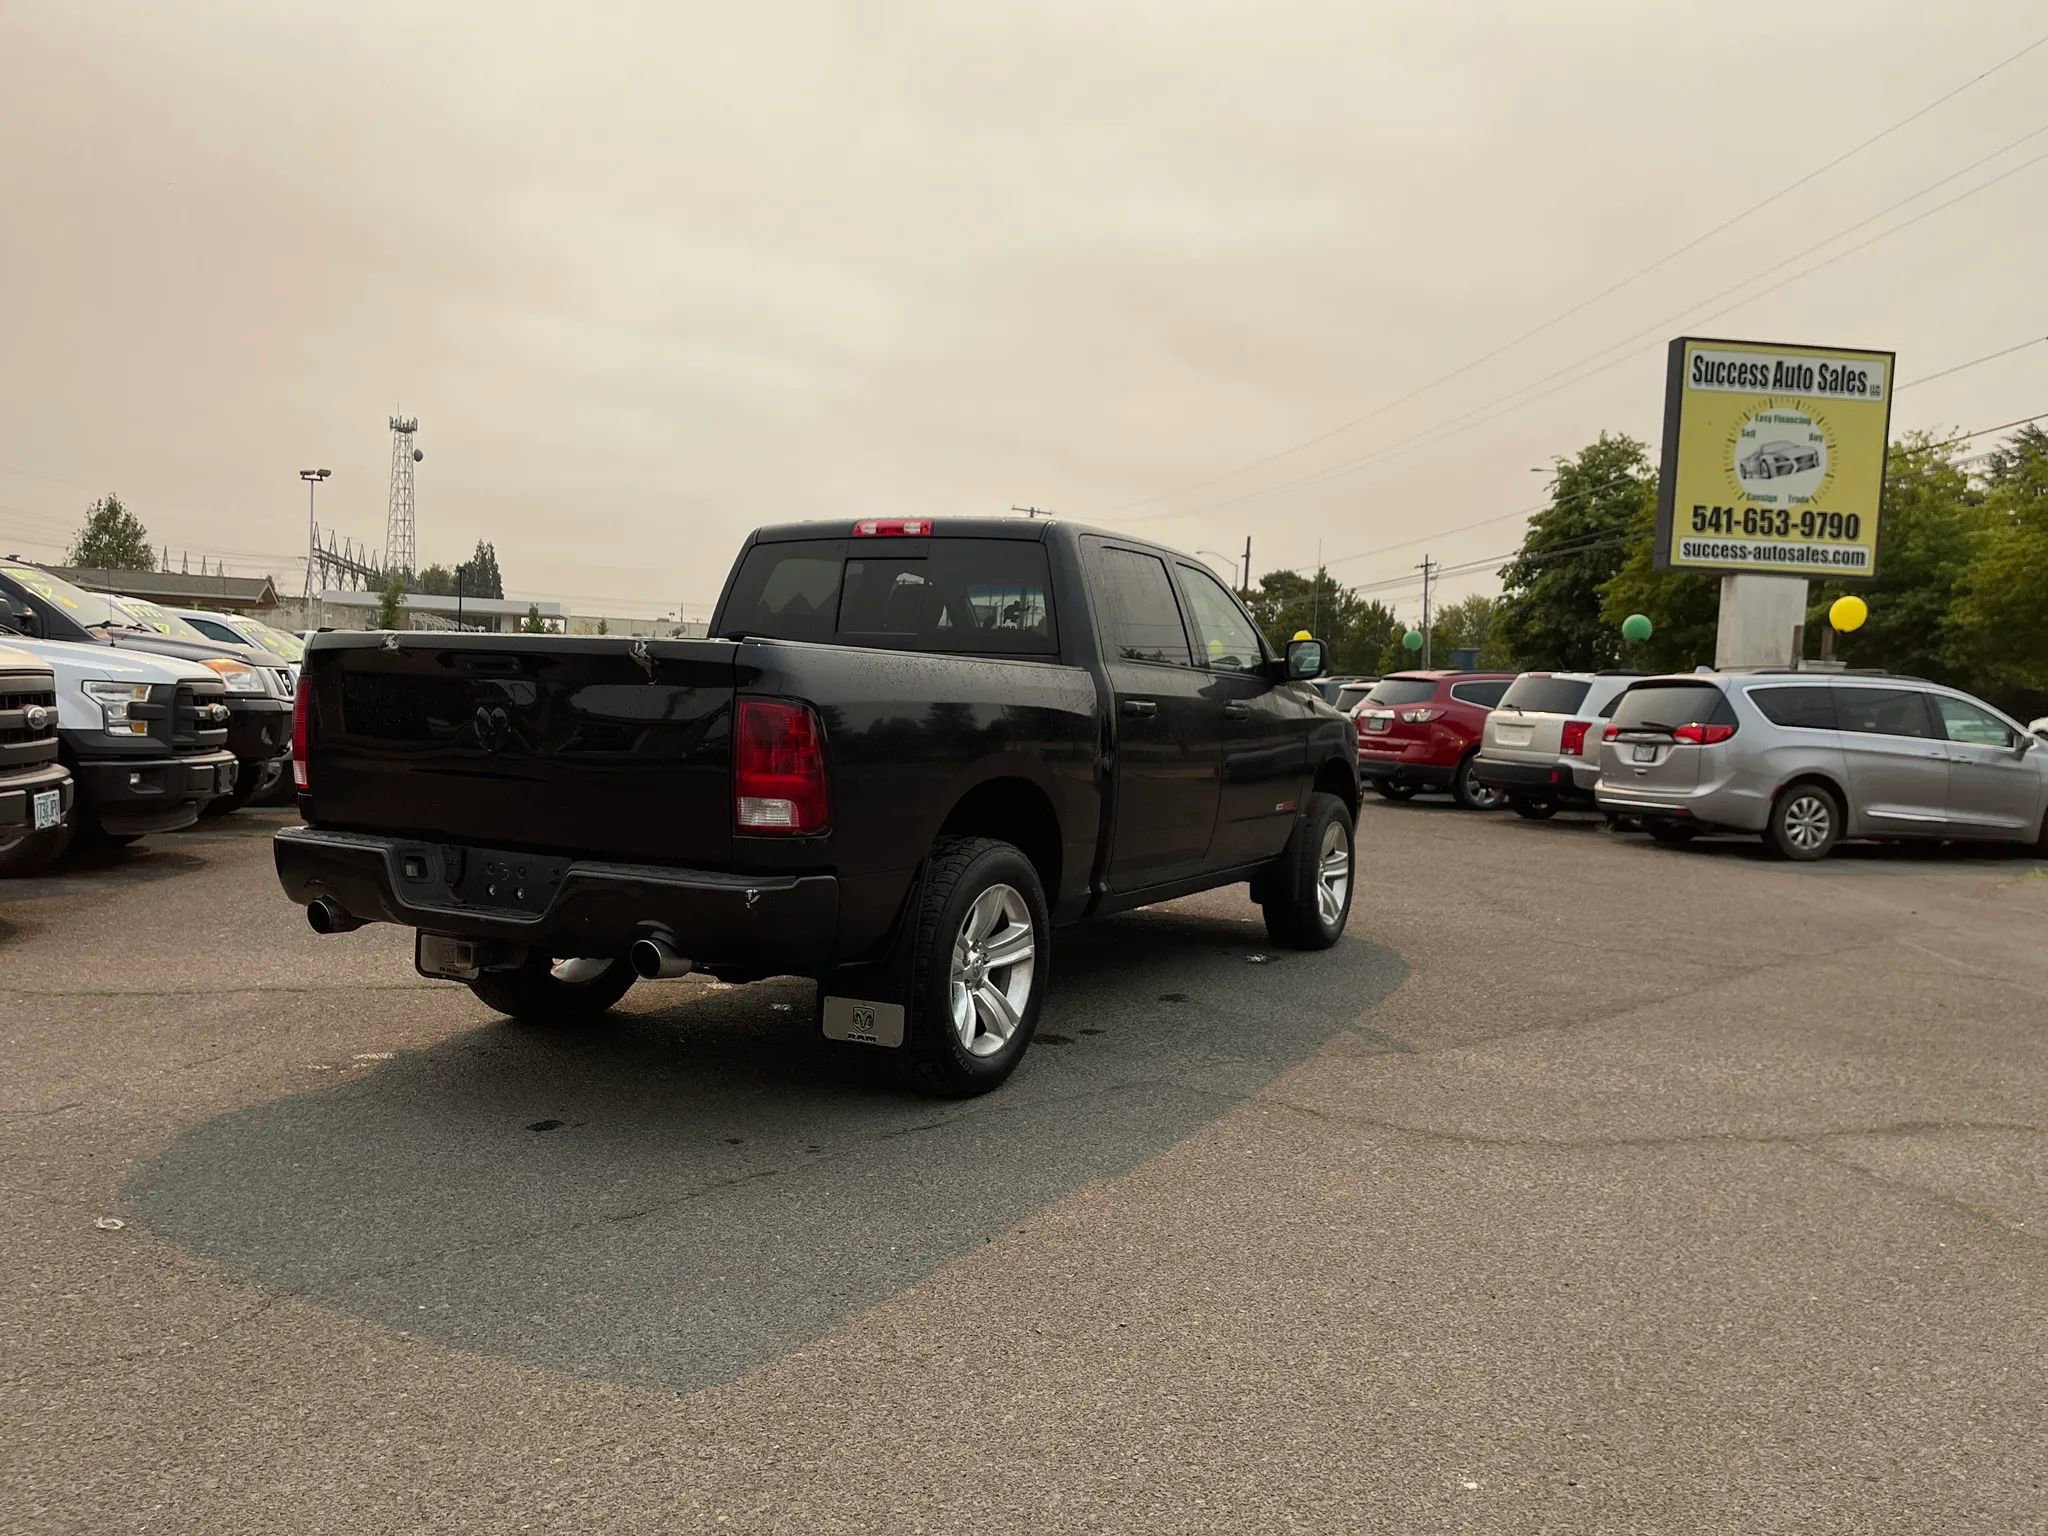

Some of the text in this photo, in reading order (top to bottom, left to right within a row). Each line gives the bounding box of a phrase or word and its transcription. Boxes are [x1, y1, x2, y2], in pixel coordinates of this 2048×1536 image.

[1692, 354, 1769, 387] Success
[1773, 360, 1814, 391] Auto
[1818, 363, 1868, 393] Sales
[1692, 505, 1860, 540] 541-653-9790
[1683, 542, 1866, 565] success-autosales.com
[847, 1032, 878, 1043] RAM
